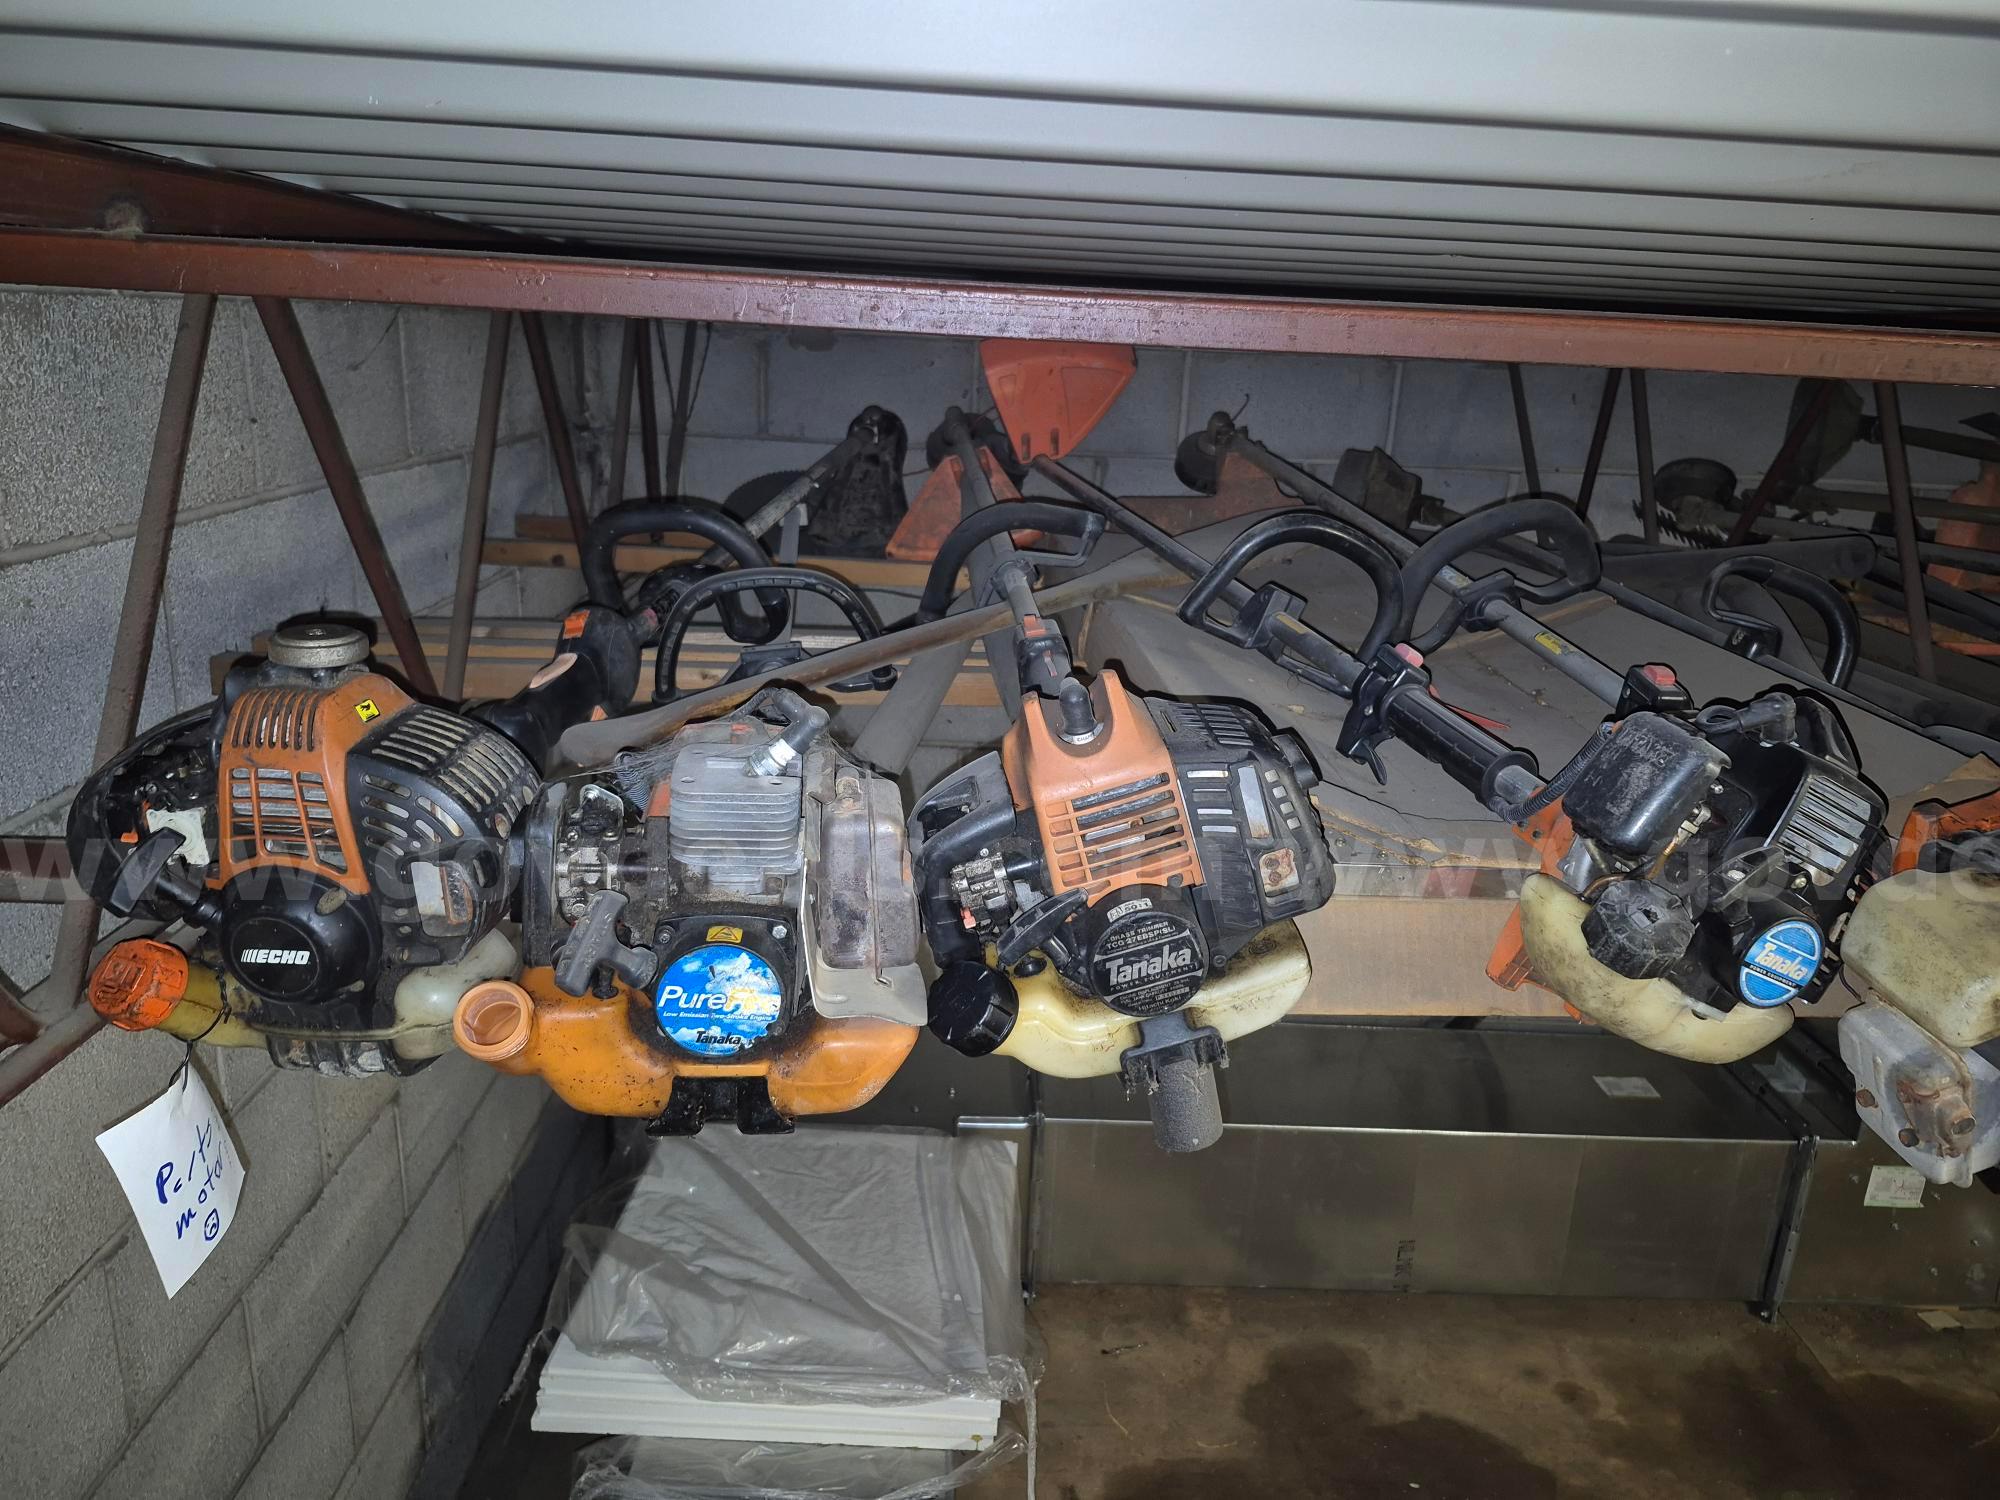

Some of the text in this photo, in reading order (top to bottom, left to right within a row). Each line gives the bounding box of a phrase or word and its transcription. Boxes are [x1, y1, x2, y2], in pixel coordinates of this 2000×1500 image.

[255, 949, 310, 965] ECHO
[1105, 944, 1192, 986] Tanaka
[1754, 941, 1808, 980] Tanaka
[695, 1030, 742, 1045] Tanaka
